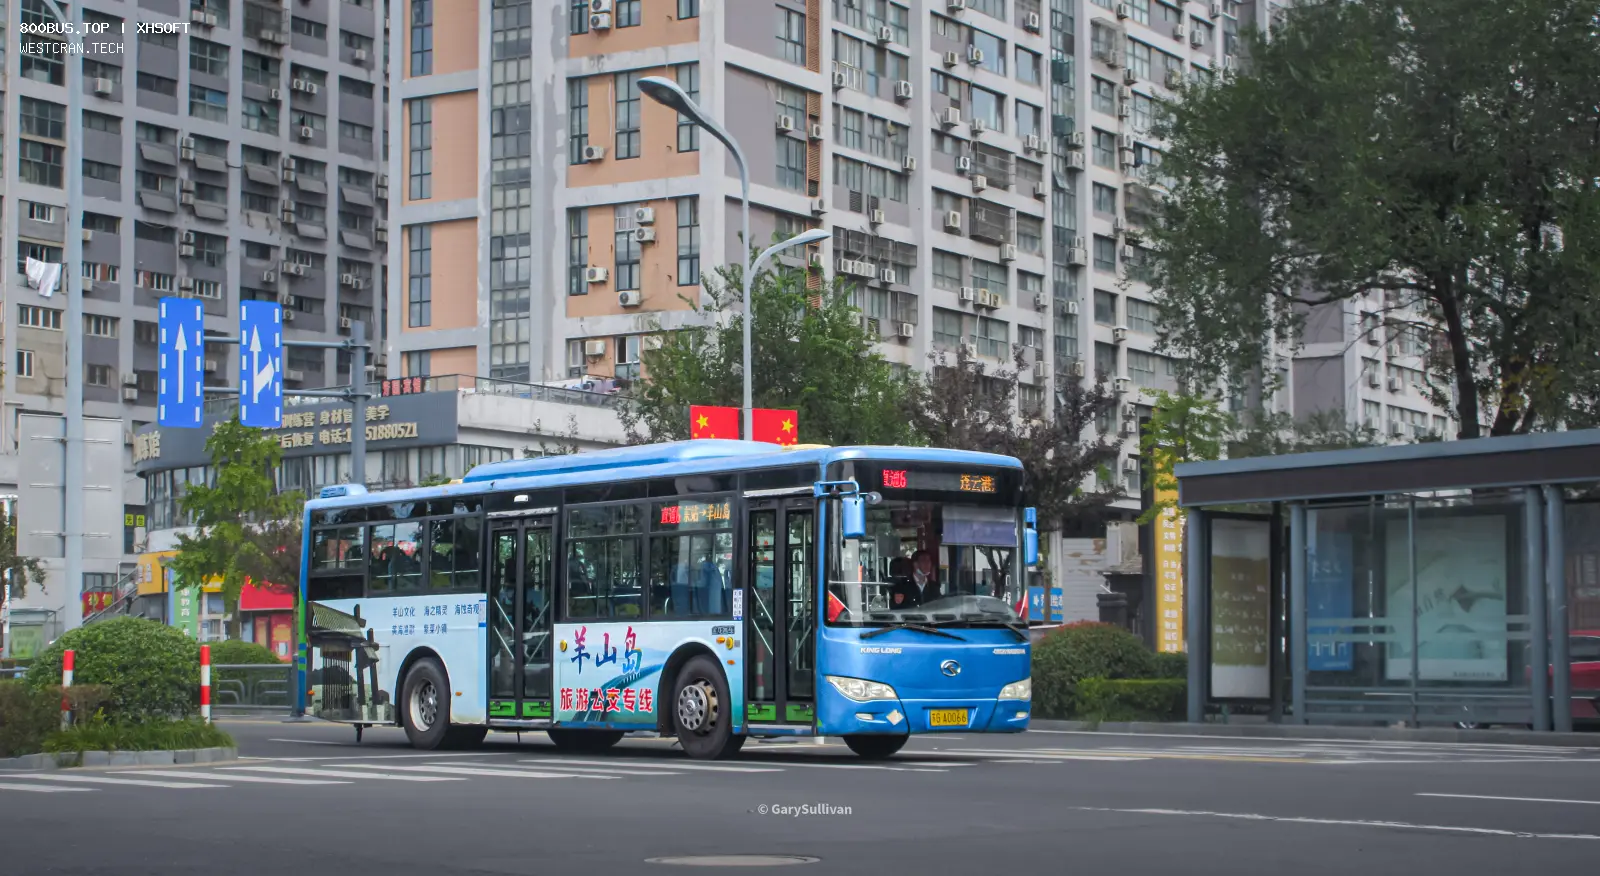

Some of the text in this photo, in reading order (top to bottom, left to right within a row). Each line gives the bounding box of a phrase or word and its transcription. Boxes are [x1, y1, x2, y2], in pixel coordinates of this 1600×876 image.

[570, 625, 643, 675] 羊山岛
[560, 687, 653, 713] 旅游公交专线
